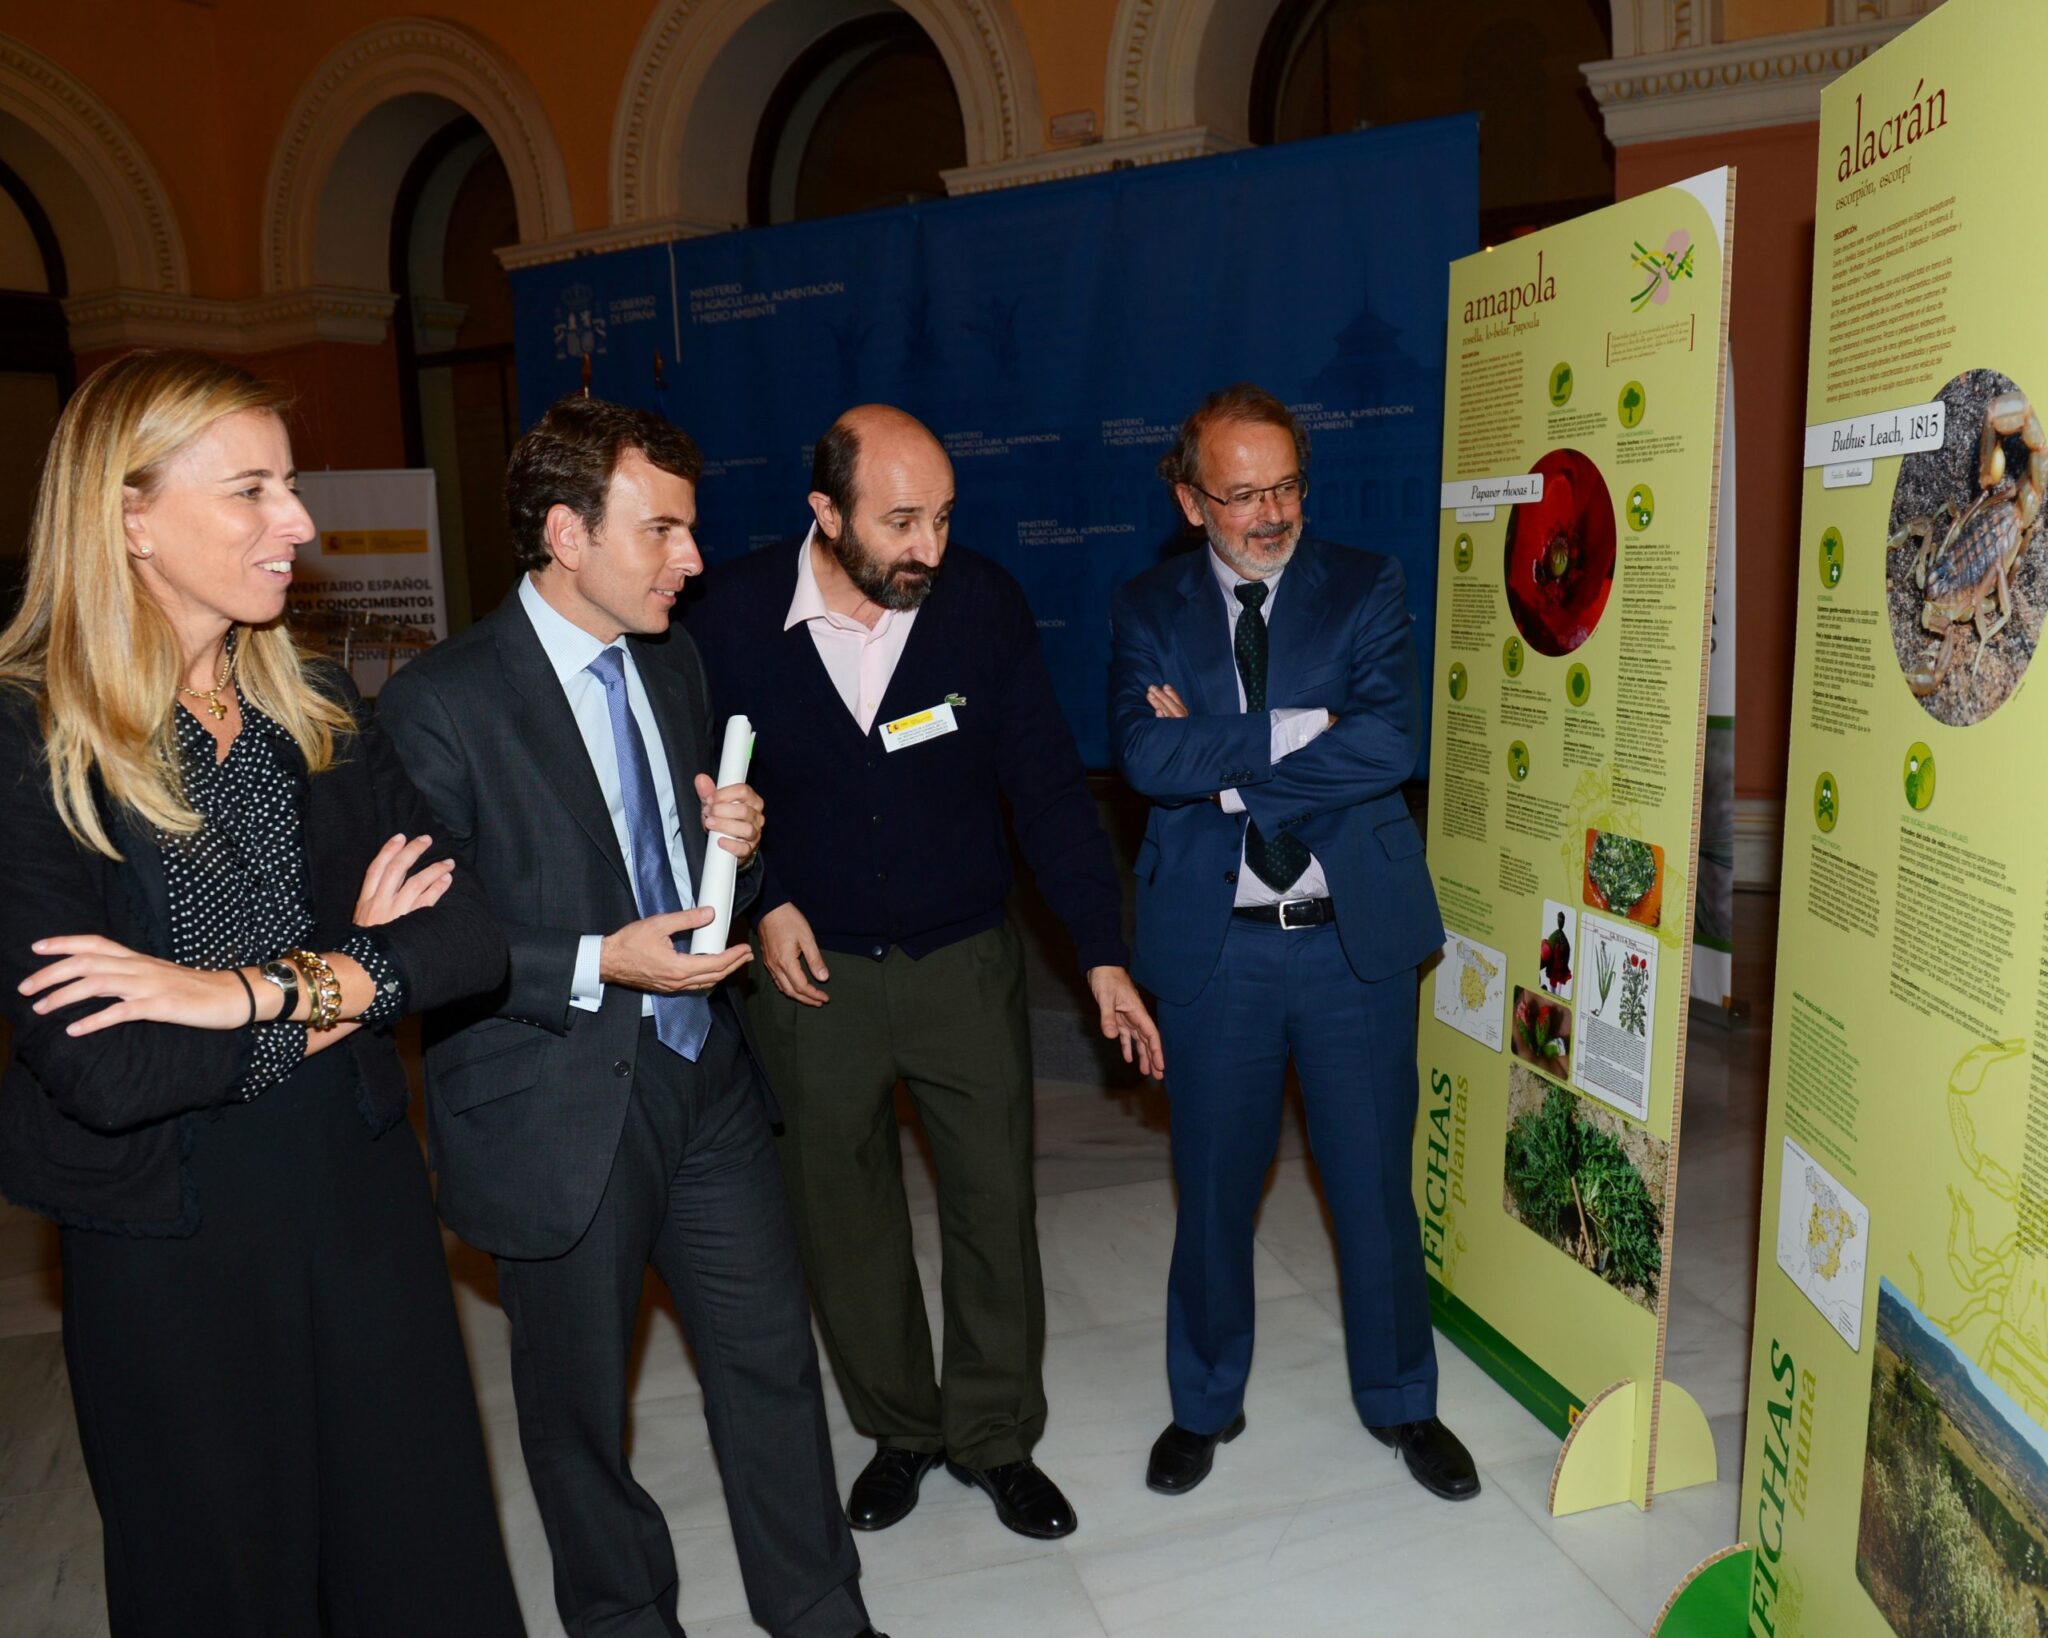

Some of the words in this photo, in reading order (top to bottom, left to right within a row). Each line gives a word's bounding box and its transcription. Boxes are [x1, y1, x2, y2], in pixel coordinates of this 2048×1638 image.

[1838, 77, 1948, 182] alacrán
[1835, 179, 1876, 211] escorpión,
[1880, 155, 1912, 188] escorpí
[690, 283, 741, 300] MINISTERIO
[1464, 250, 1556, 325] amapola
[691, 301, 702, 312] DE
[771, 281, 845, 301] ALIMENTACIÓN
[692, 314, 698, 325] Y
[700, 309, 729, 323] MEDIO
[732, 303, 776, 319] AMBIENTE
[1513, 311, 1540, 336] papoula
[1350, 404, 1414, 418] ALIMENTACIÓN
[1102, 416, 1144, 428] MINISTERIO
[1312, 419, 1353, 429] AMBIENTE
[1005, 432, 1060, 444] ALIMENTACIÓN
[1109, 436, 1134, 446] MEDIO
[1136, 432, 1174, 444] AMBIENTE
[1831, 424, 1865, 452] Buthus
[1869, 416, 1904, 447] Leach,
[1909, 413, 1939, 440] 1815
[975, 446, 1009, 456] AMBIENTE
[1471, 485, 1500, 501] Papaver
[1531, 480, 1540, 495] L.
[1017, 519, 1058, 529] MINISTERIO
[1018, 529, 1027, 537] DE
[1080, 523, 1135, 535] ALIMENTACIÓN
[1025, 537, 1048, 546] MEDIO
[1050, 535, 1083, 545] AMBIENTE
[367, 577, 432, 591] ESPAÑOL
[316, 597, 435, 610] CONOCIMIENTOS
[1036, 616, 1066, 628] TACIÓN
[1449, 1075, 1468, 1208] plantas
[1424, 1068, 1451, 1272] FICHAS
[1789, 1368, 1817, 1521] fauna
[1752, 1338, 1796, 1638] FICHAS
